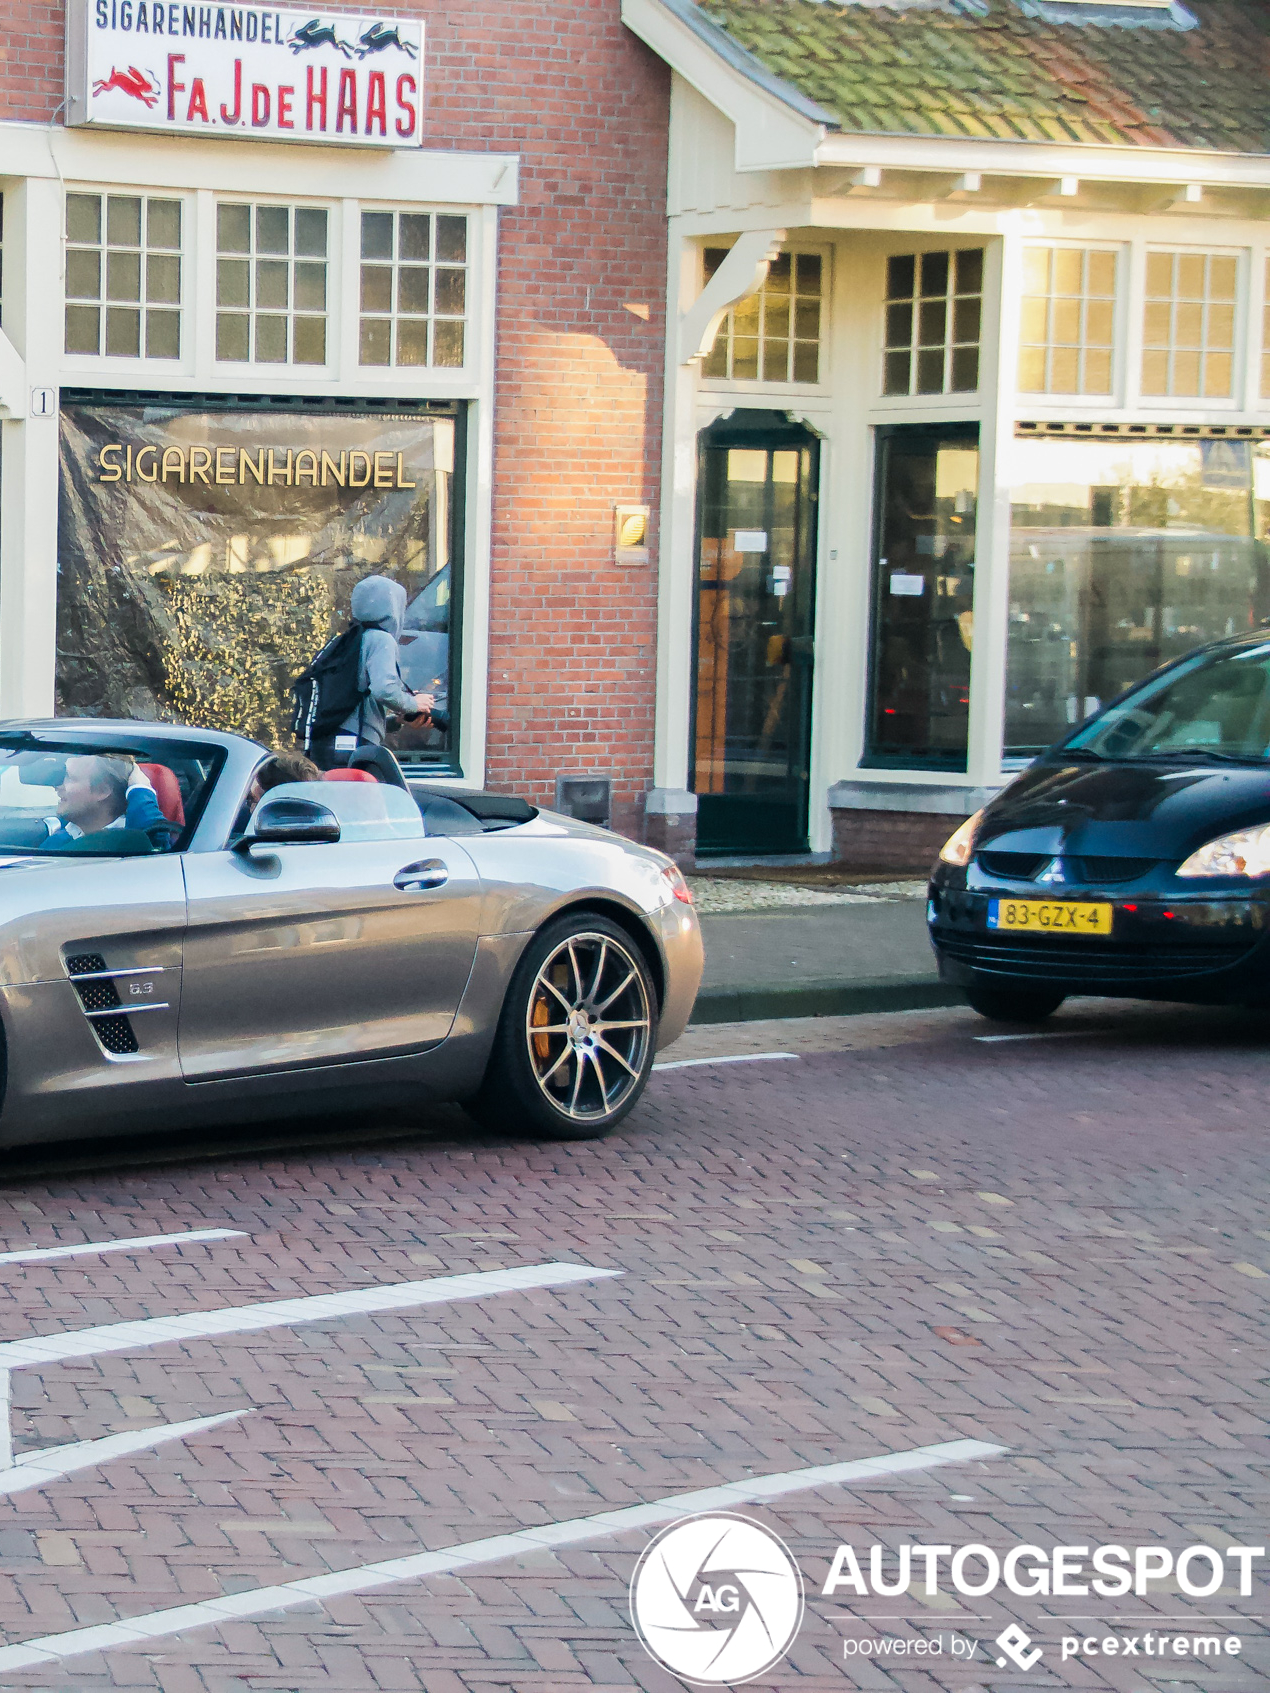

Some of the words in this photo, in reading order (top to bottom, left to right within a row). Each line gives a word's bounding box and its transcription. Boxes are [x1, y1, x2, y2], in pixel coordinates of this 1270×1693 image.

[96, 0, 284, 46] SIGARENHANDEL
[306, 65, 417, 138] HAAS
[40, 391, 47, 414] 1
[98, 443, 417, 488] SIGARENHANDEL
[1005, 904, 1100, 928] 83-GZX-4
[130, 982, 153, 995] 6.3
